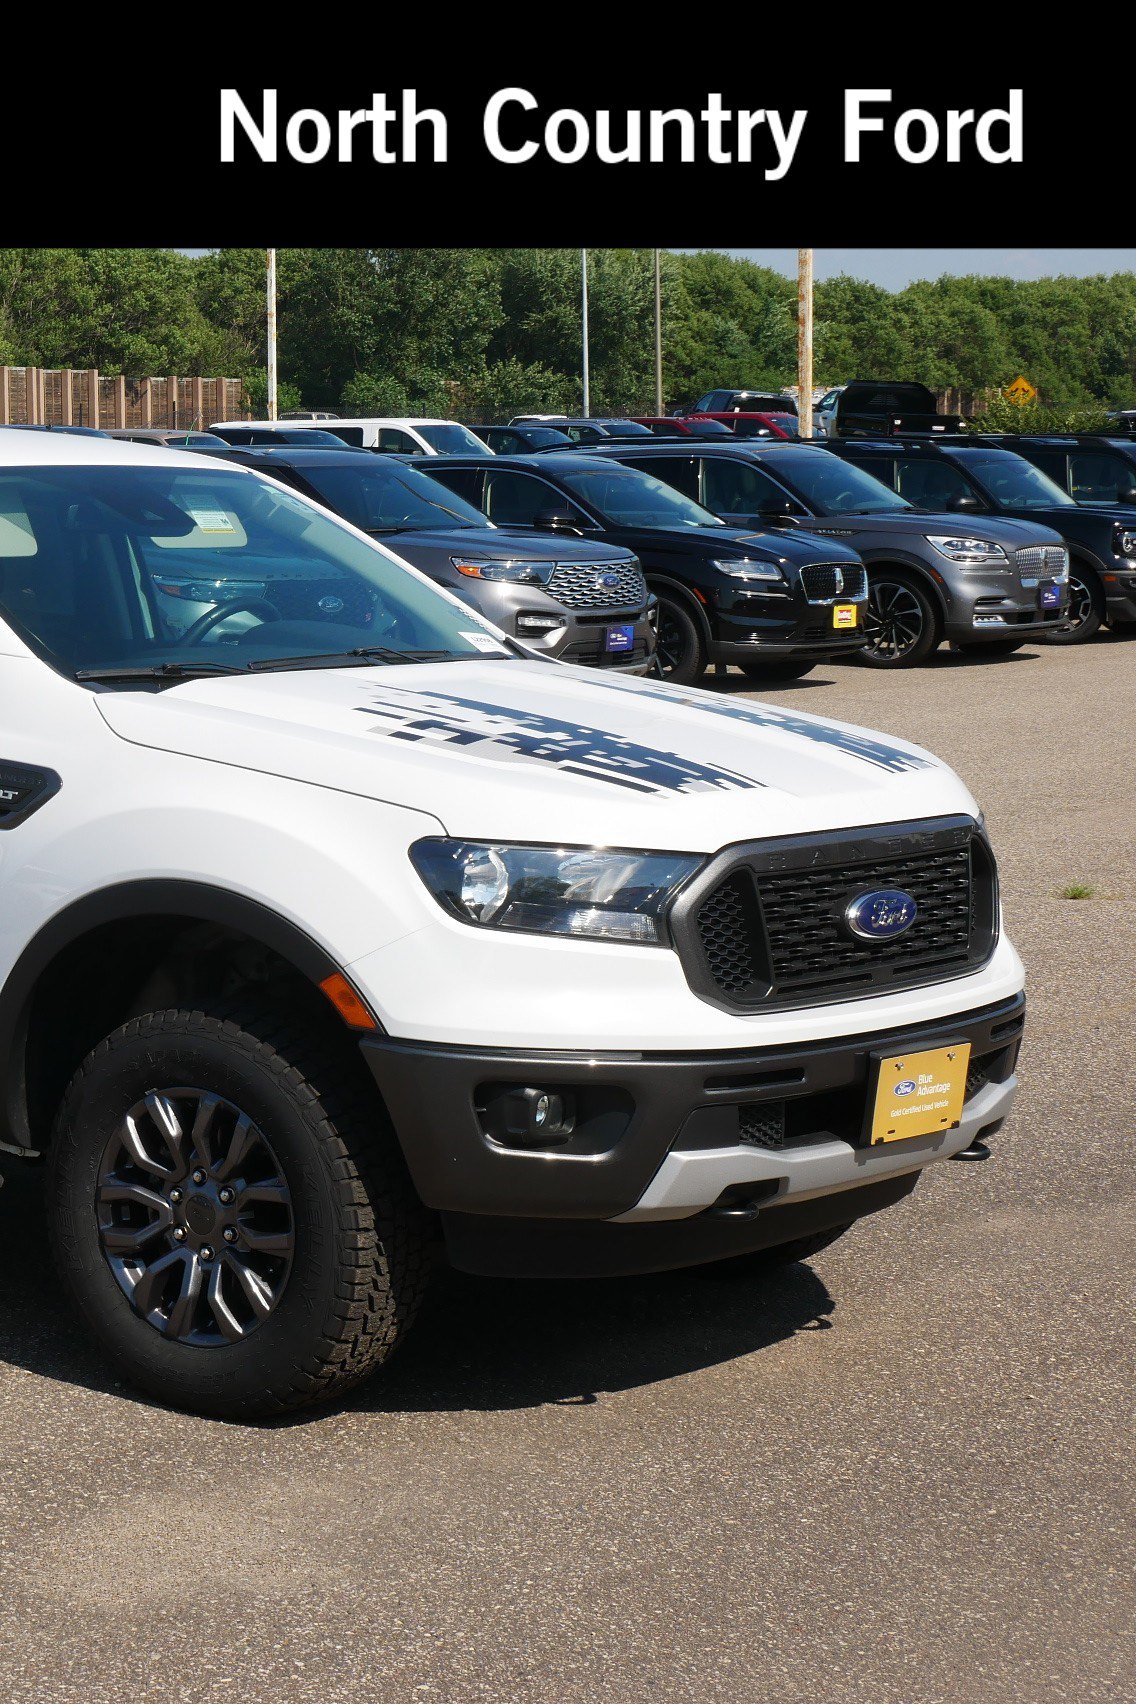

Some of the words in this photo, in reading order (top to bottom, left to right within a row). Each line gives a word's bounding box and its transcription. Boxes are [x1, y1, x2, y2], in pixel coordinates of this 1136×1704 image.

[871, 899, 907, 928] Ford
[918, 1073, 933, 1085] Blue
[897, 1081, 913, 1095] Ford
[917, 1082, 951, 1097] Advantage
[890, 1108, 902, 1118] Gold
[901, 1104, 922, 1116] Certified
[921, 1102, 934, 1112] Used
[934, 1099, 949, 1109] Vehicle
